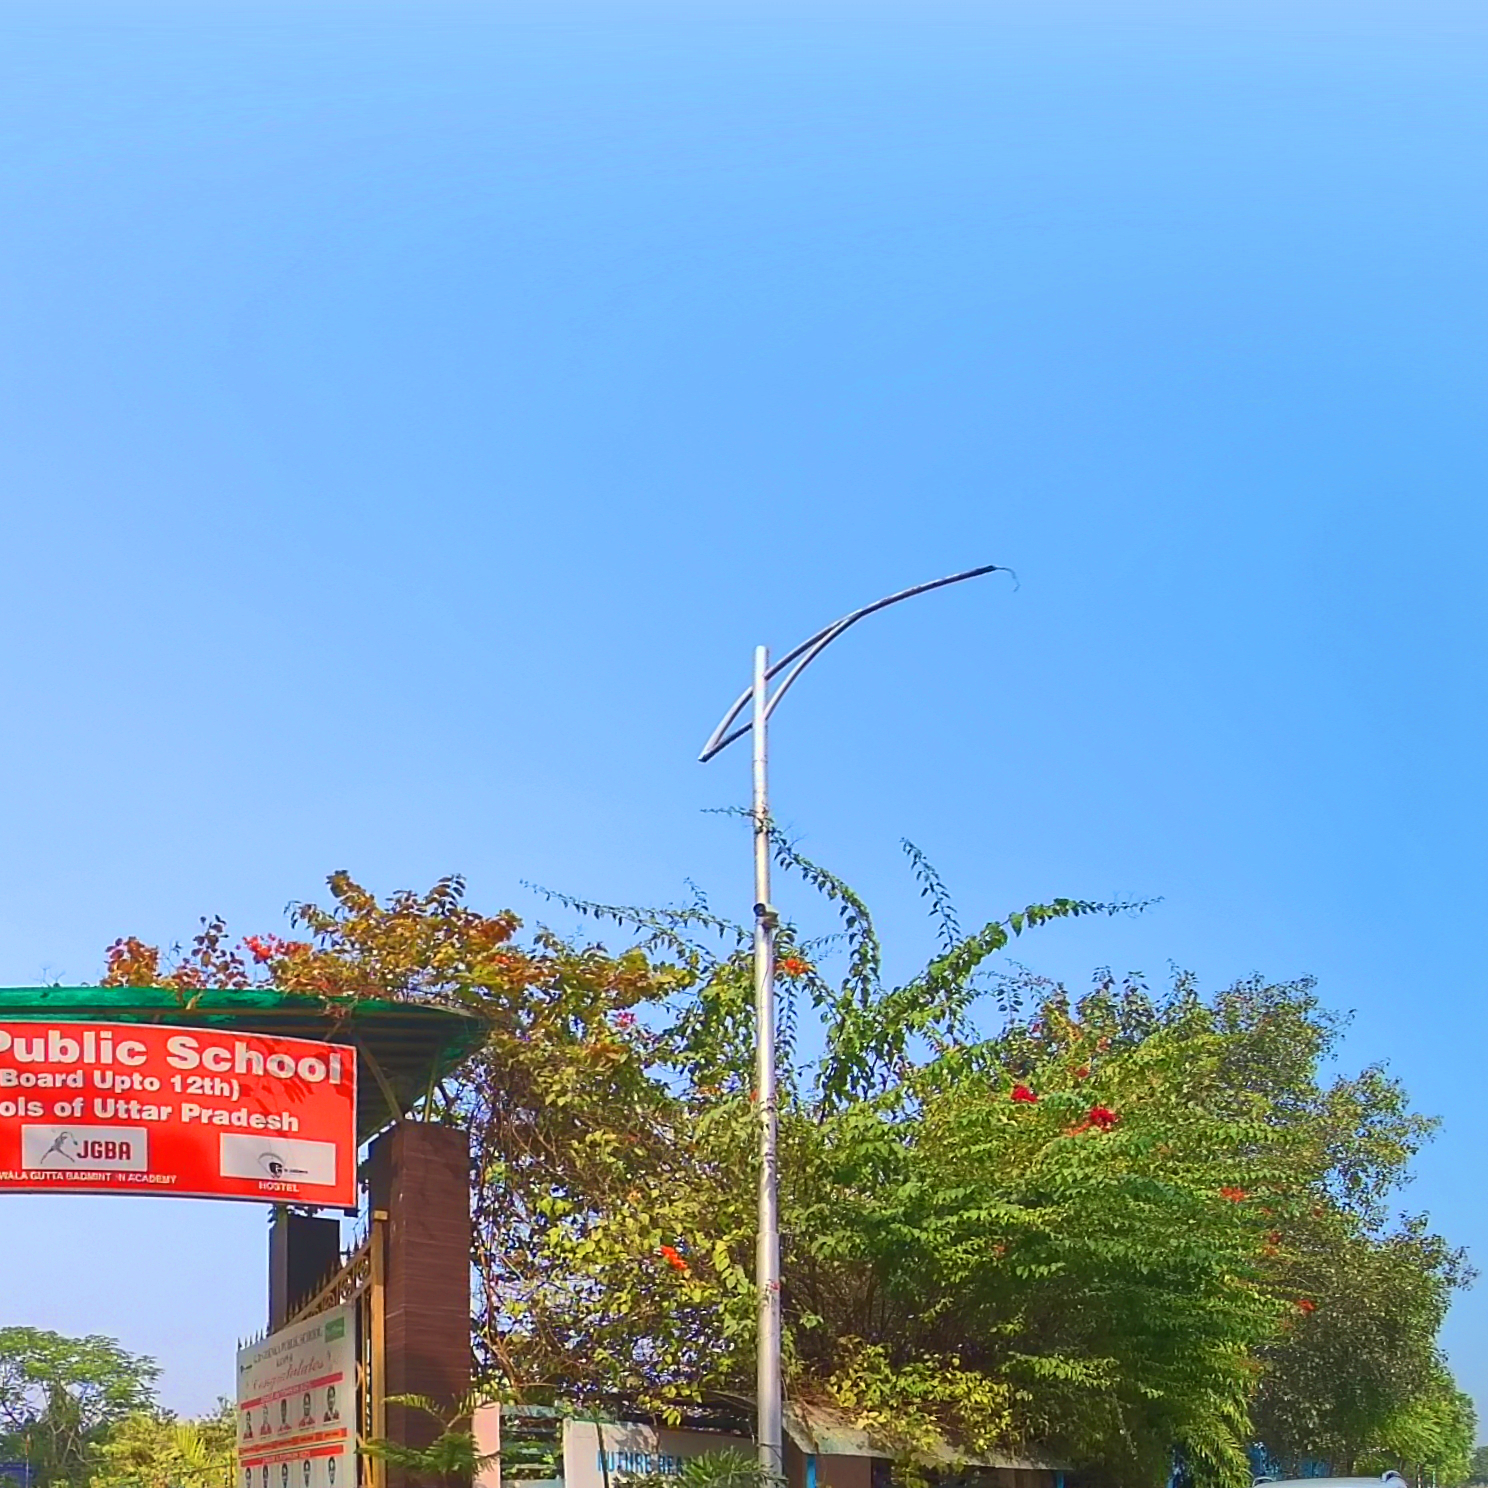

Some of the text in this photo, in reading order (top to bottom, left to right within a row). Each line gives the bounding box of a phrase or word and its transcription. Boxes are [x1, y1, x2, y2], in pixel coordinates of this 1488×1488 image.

[166, 1035, 342, 1085] School
[0, 1069, 84, 1089] Board
[93, 1070, 160, 1094] Upto
[171, 1073, 240, 1101] 12th)
[63, 1098, 84, 1118] of
[93, 1101, 172, 1123] Uttar
[181, 1103, 299, 1133] Pradesh
[77, 1141, 131, 1160] JGBA
[30, 1171, 64, 1181] GUTTA
[66, 1172, 126, 1182] BADMINTN
[128, 1173, 177, 1184] ACADEMY
[259, 1181, 299, 1192] HOSTEL
